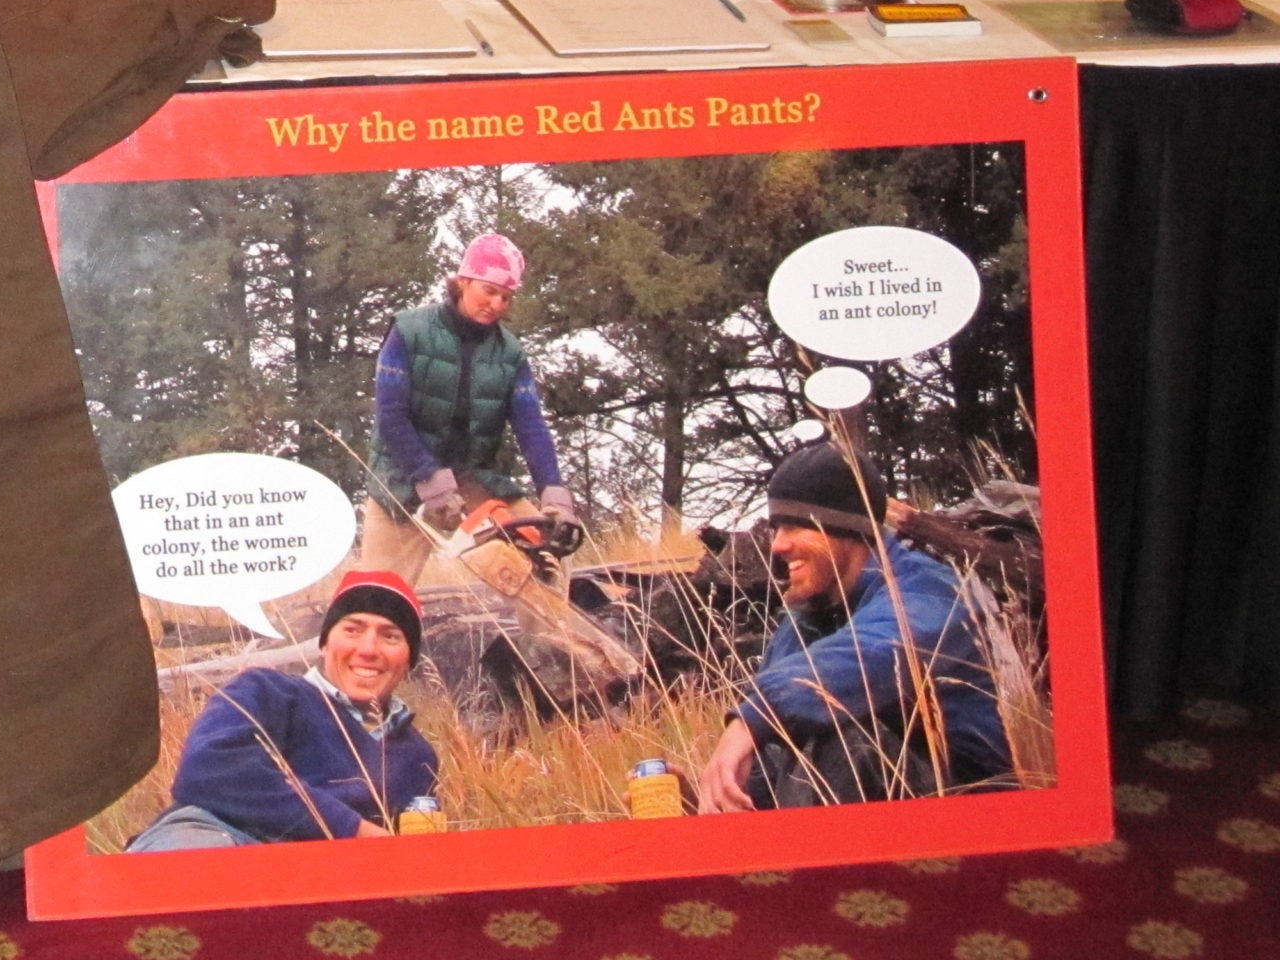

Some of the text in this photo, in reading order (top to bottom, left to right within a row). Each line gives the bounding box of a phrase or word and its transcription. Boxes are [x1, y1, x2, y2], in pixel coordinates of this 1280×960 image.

[265, 93, 822, 152] Why the name Red Ants Pants?
[843, 258, 909, 275] Sweet...
[812, 277, 942, 299] I wish I lived in
[818, 300, 937, 321] an ant colony!
[139, 488, 307, 512] Hey, Did you know
[164, 511, 284, 532] that in an ant
[142, 535, 308, 557] colony, the women
[155, 555, 297, 578] do all the work?
